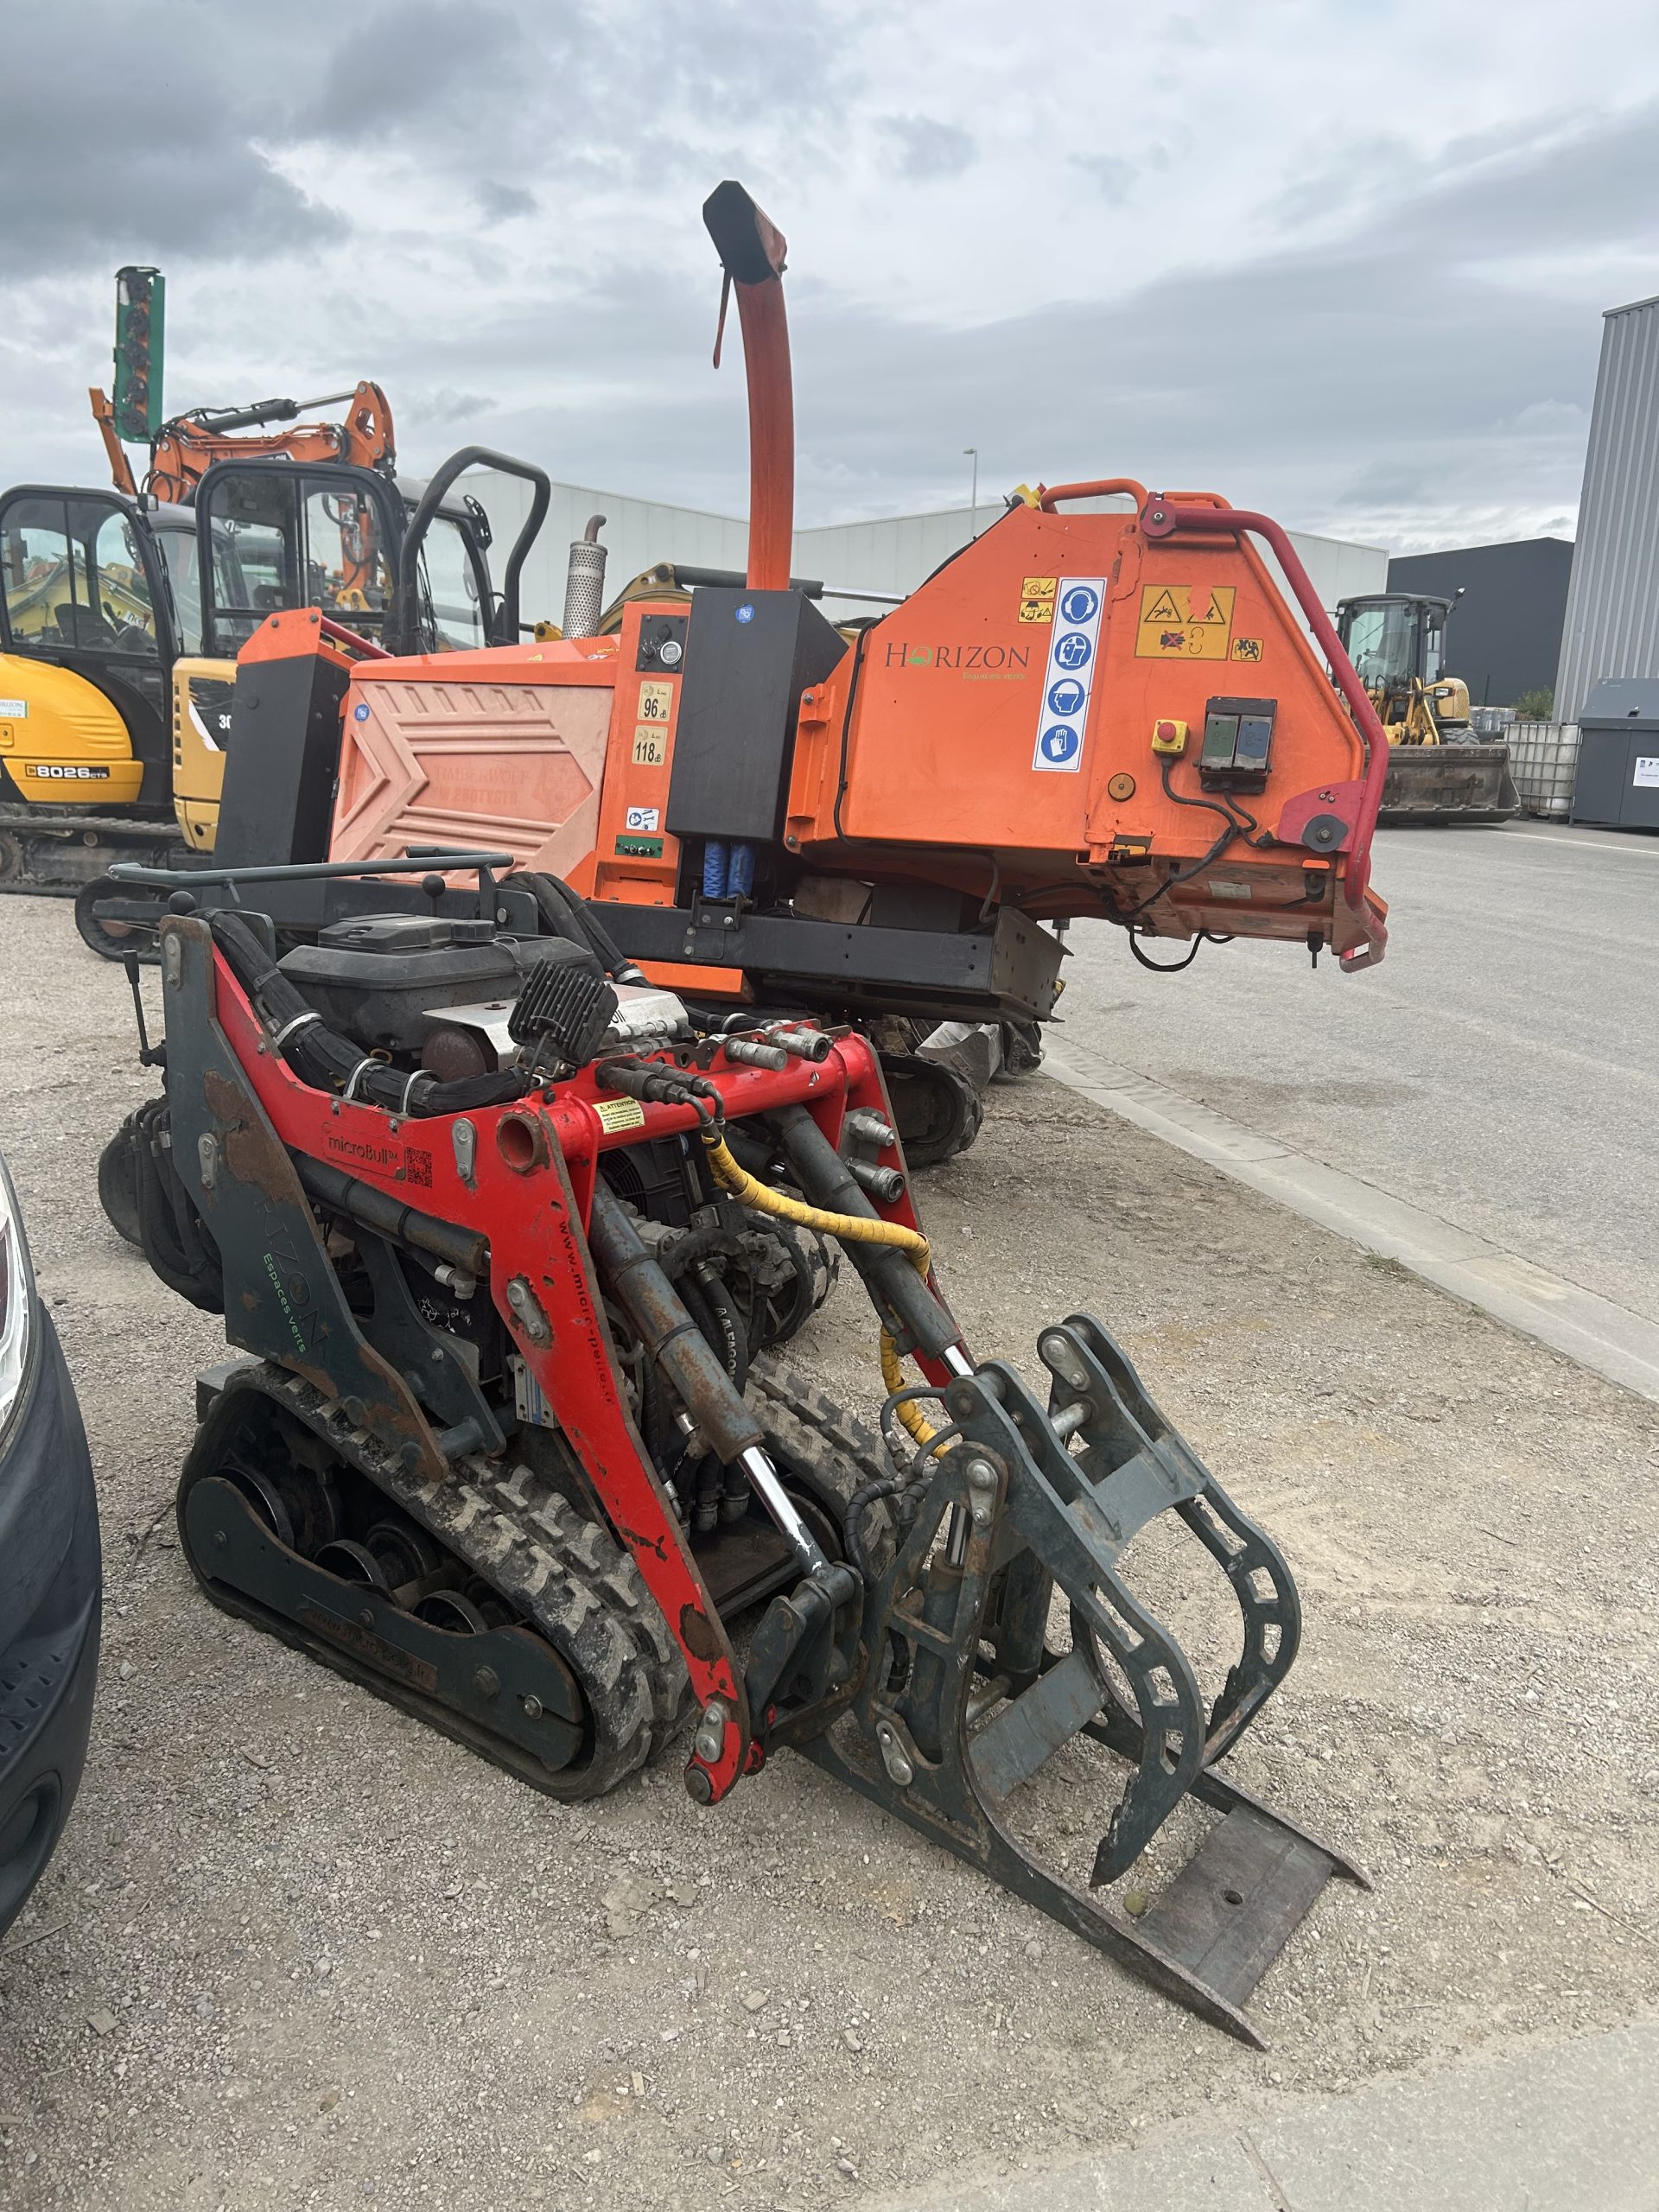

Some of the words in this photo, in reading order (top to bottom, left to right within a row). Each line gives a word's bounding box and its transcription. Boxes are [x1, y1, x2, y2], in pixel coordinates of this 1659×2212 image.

[644, 698, 658, 718] 96
[659, 709, 667, 719] dB
[636, 741, 656, 762] 118
[654, 753, 662, 763] dB
[36, 766, 91, 779] 8026
[607, 1100, 637, 1110] ATTENTION
[263, 1253, 291, 1314] Espaces
[288, 1315, 307, 1354] verts
